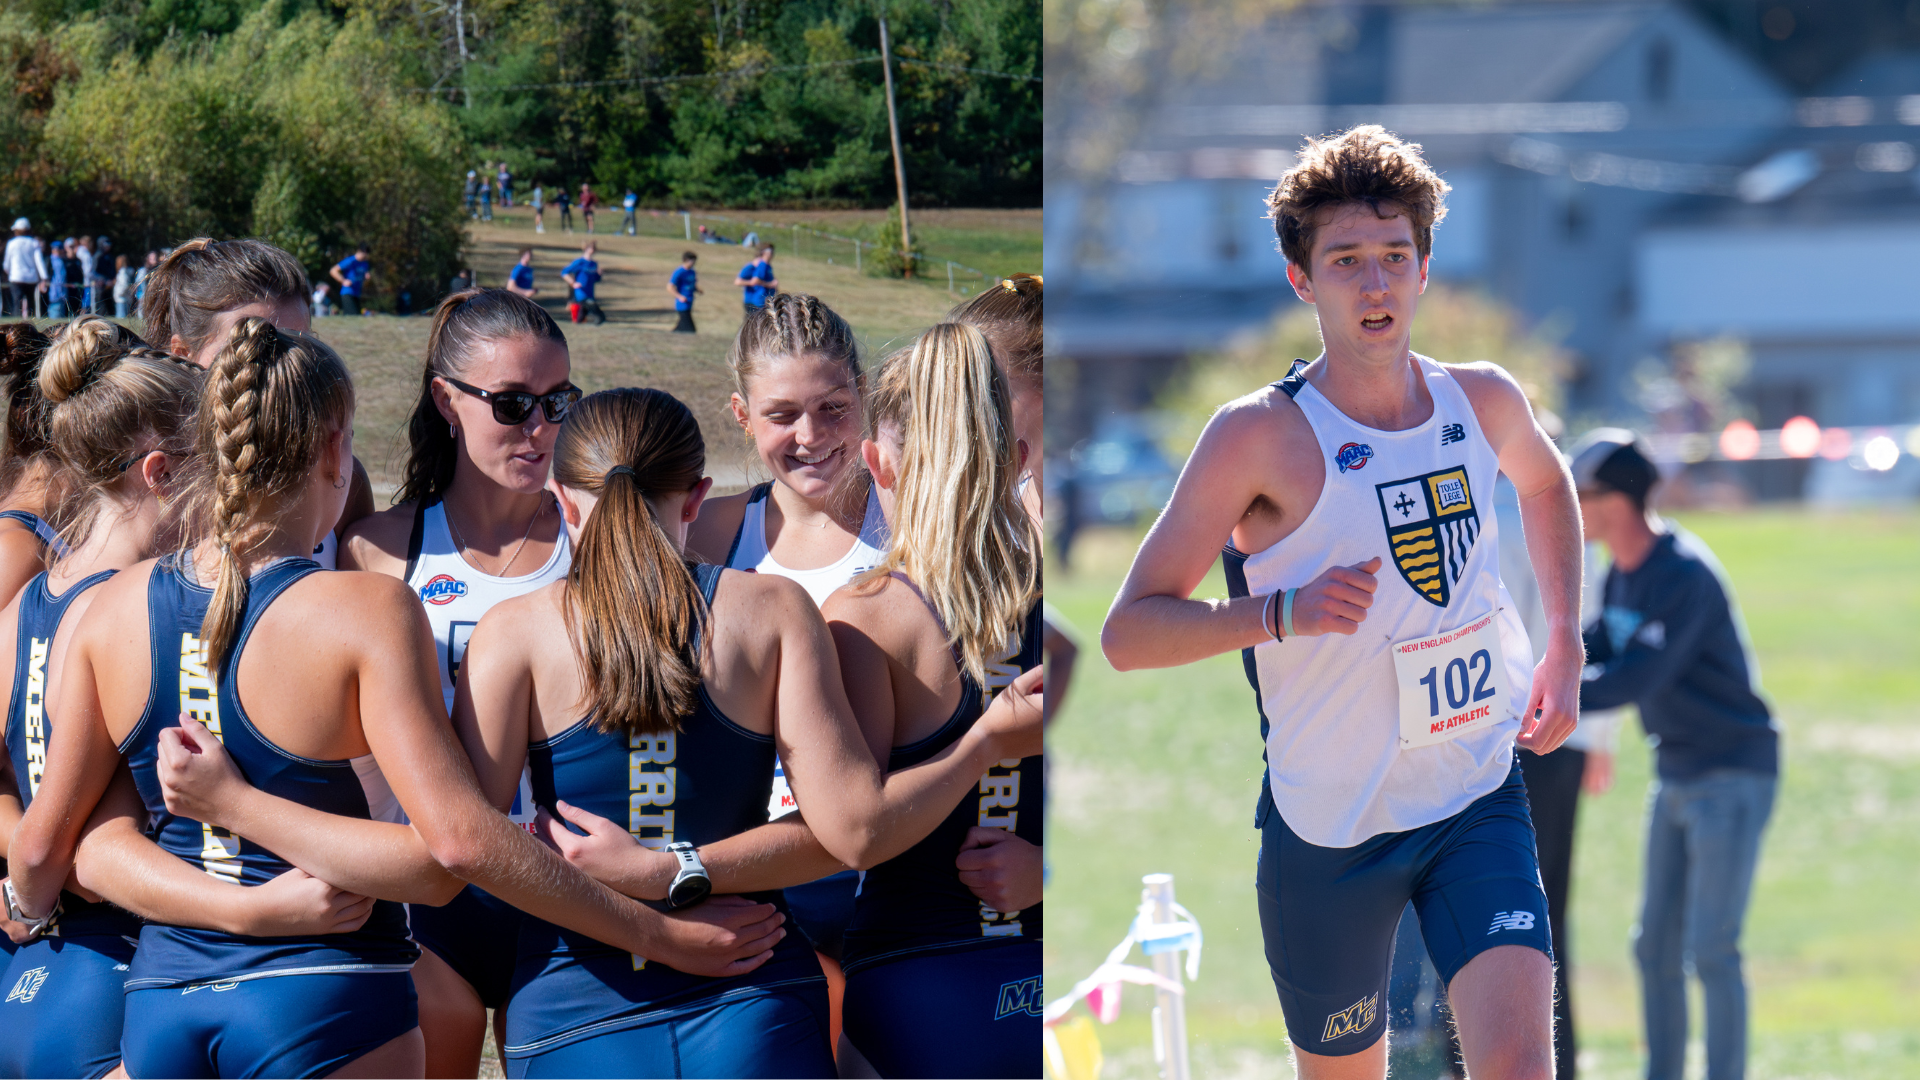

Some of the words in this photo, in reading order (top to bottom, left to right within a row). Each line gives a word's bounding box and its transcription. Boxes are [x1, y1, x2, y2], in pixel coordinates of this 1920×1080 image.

[1335, 443, 1374, 474] MAAC
[1439, 481, 1461, 493] TOLLE
[1443, 491, 1462, 502] LEGE
[419, 581, 468, 603] MAAC
[1401, 642, 1419, 653] NEW
[1420, 634, 1453, 650] ENGLAND
[1453, 616, 1492, 641] CHAMPIONSHIPS
[1420, 649, 1496, 717] 102
[1446, 705, 1490, 729] ATHLETIC
[1487, 910, 1535, 935] NB
